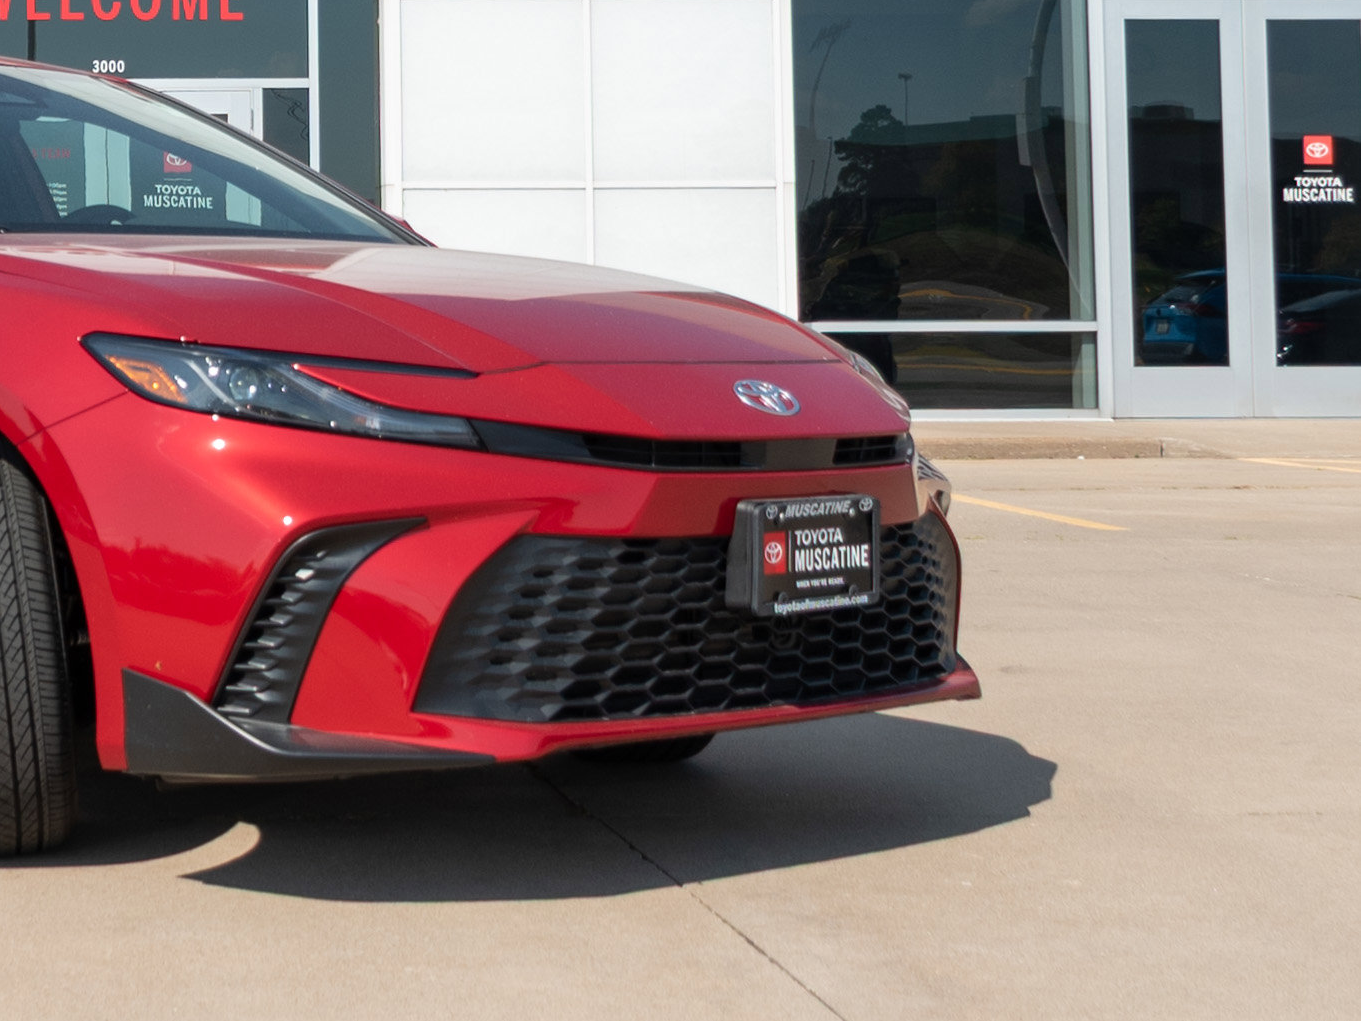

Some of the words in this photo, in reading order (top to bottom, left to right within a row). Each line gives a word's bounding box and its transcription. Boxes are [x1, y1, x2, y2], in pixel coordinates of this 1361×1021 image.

[92, 59, 125, 73] 3000
[1294, 177, 1342, 187] TOYOTA
[155, 184, 201, 195] TOYOTA
[1283, 188, 1354, 202] MUSCATINE
[143, 195, 213, 209] MUSCATINE
[785, 501, 850, 517] MUSCATINE
[795, 528, 843, 545] TOYOTA
[795, 544, 869, 571] MUSCATINE
